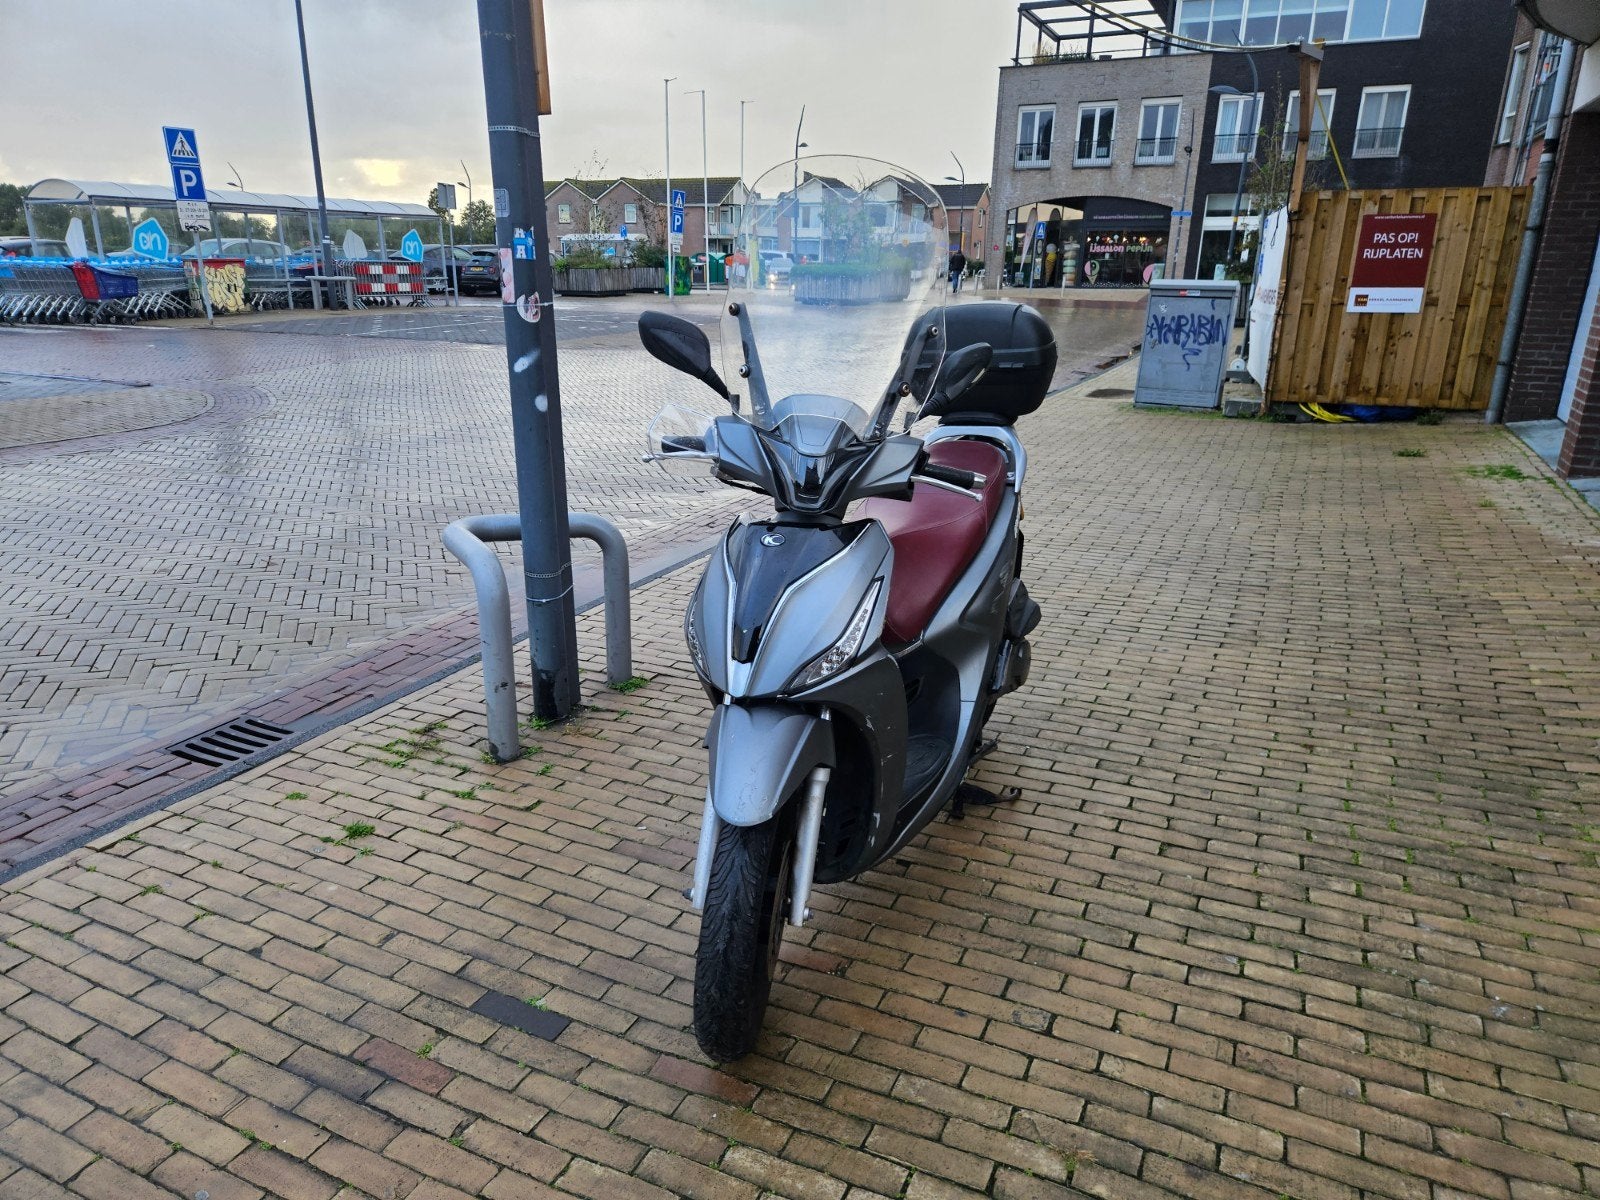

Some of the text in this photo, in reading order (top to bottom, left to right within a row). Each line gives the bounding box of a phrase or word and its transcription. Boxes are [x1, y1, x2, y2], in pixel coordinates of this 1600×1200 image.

[180, 169, 198, 197] P
[674, 214, 682, 231] P
[1373, 232, 1419, 244] PAS OP!
[1362, 247, 1424, 259] RIJPLATEN
